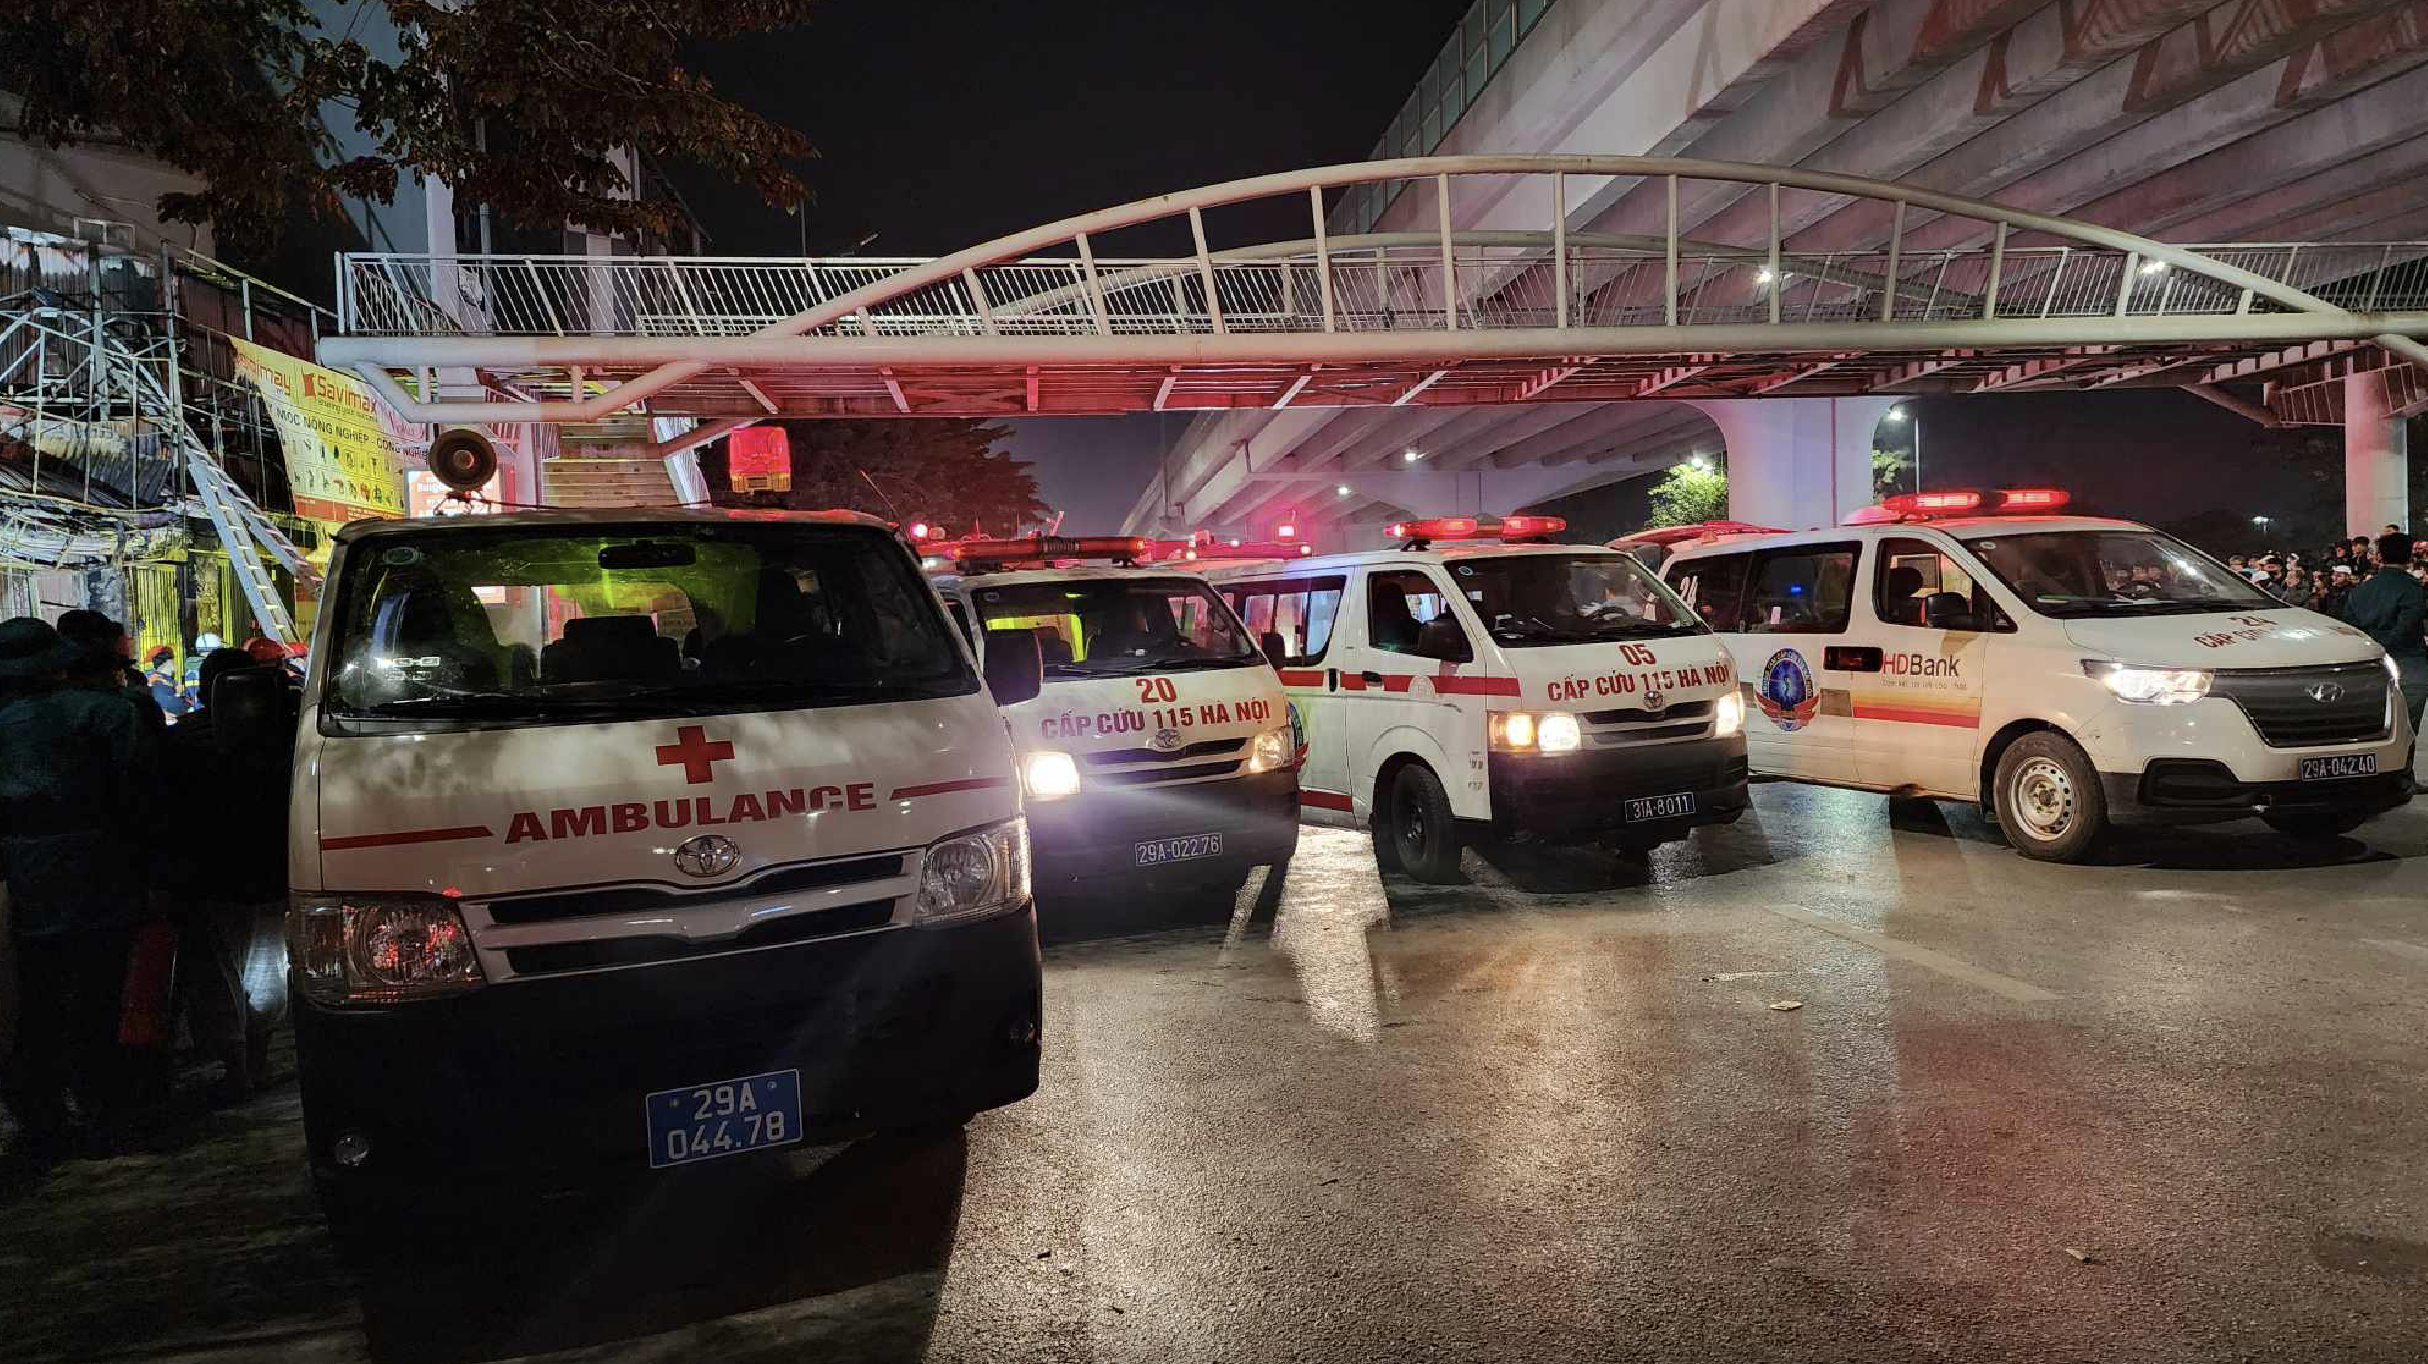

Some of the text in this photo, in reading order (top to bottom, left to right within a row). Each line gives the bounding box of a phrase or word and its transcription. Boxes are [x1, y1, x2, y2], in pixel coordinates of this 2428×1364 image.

[1619, 643, 1657, 665] 05
[1883, 653, 1960, 676] HDBank
[1136, 677, 1177, 703] 20
[1548, 661, 1731, 701] CẤP CỨU 115 HÀ NỘI
[1041, 696, 1271, 739] CẤP CỨU 115 HÀ NỘI
[504, 783, 877, 844] AMBULANCE
[693, 1082, 757, 1120] 29A
[667, 1110, 785, 1160] 044.78
